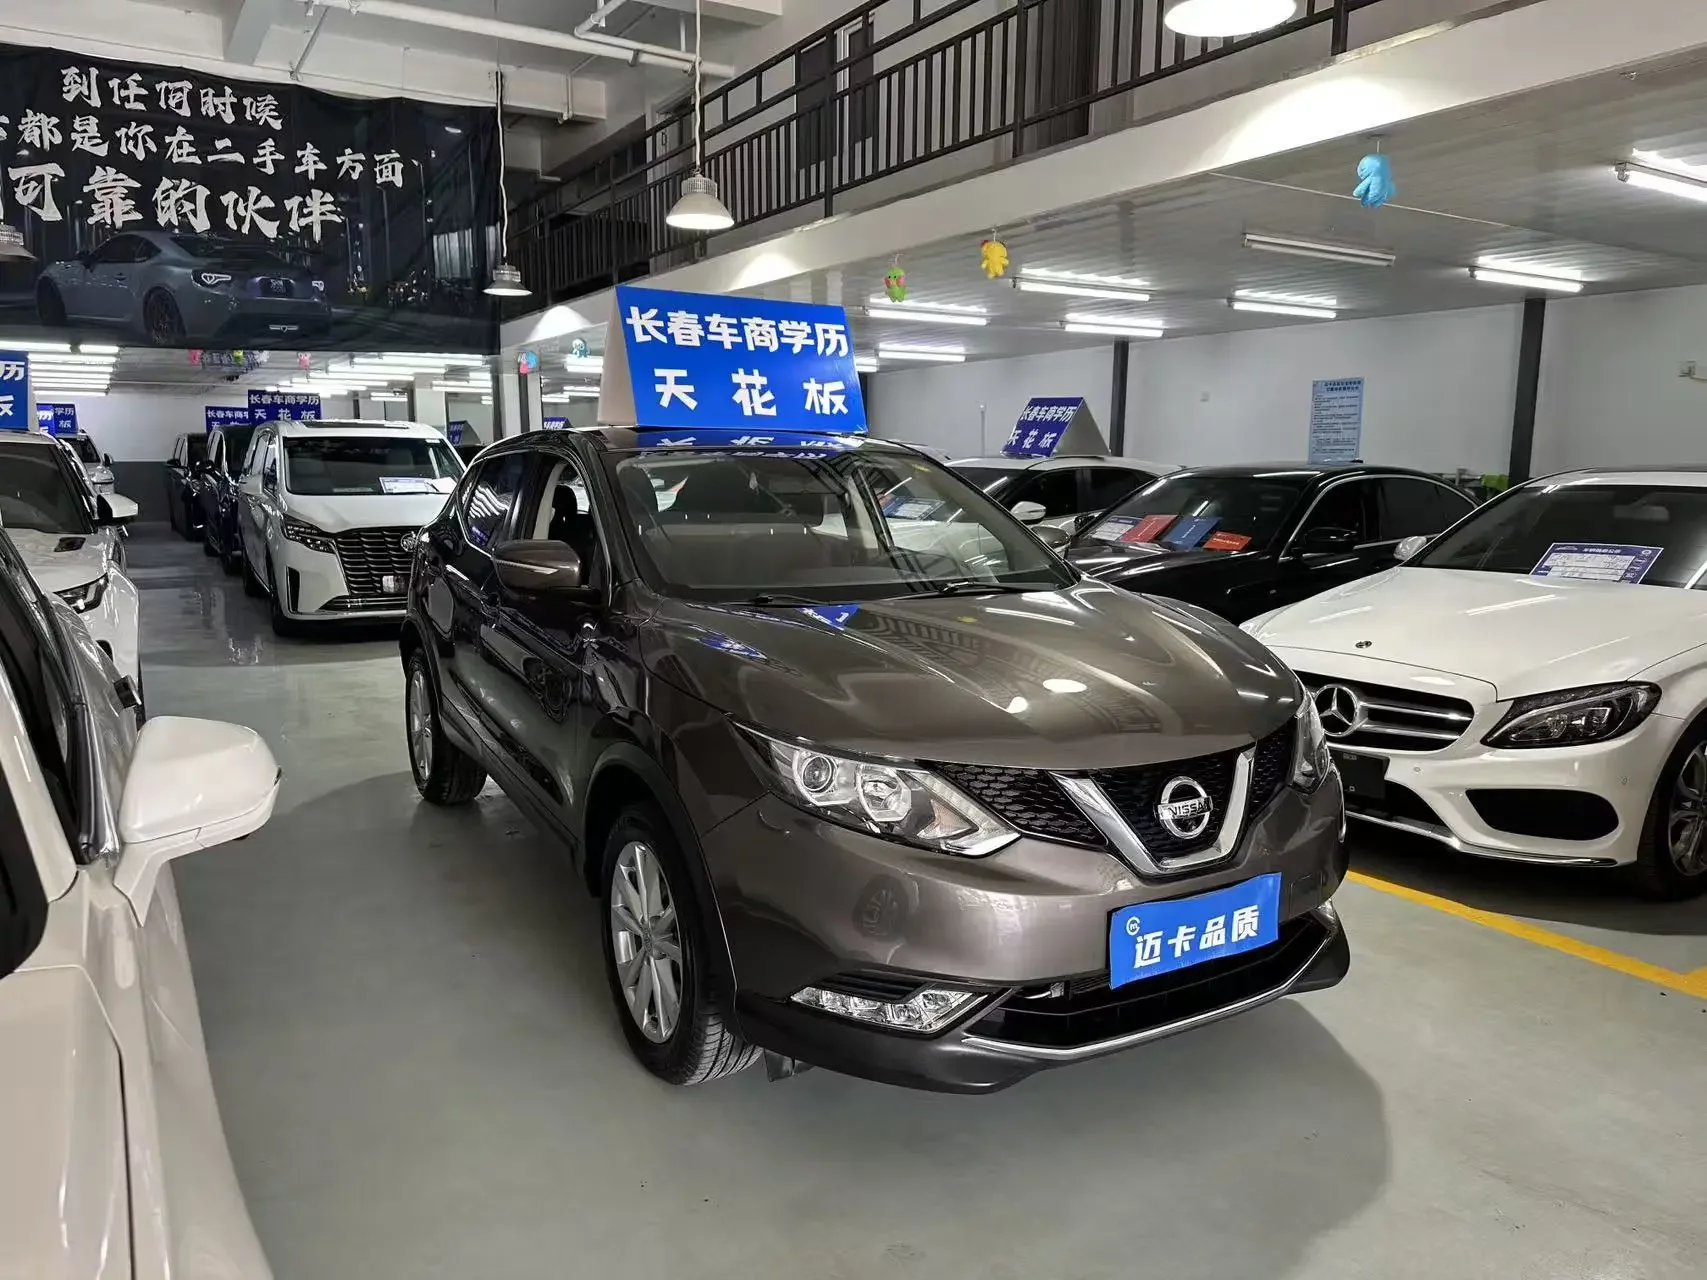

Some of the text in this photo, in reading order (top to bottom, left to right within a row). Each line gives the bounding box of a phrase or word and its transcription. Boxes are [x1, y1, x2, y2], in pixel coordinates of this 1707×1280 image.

[60, 66, 284, 131] 到任何时候
[0, 162, 344, 243] 可靠的伙伴
[626, 306, 849, 357] 长春车商学历
[249, 394, 320, 405] 长春车商学历
[653, 368, 849, 416] 天花板
[1019, 405, 1078, 422] 长春车商学历
[1133, 904, 1259, 969] 迈卡品质
